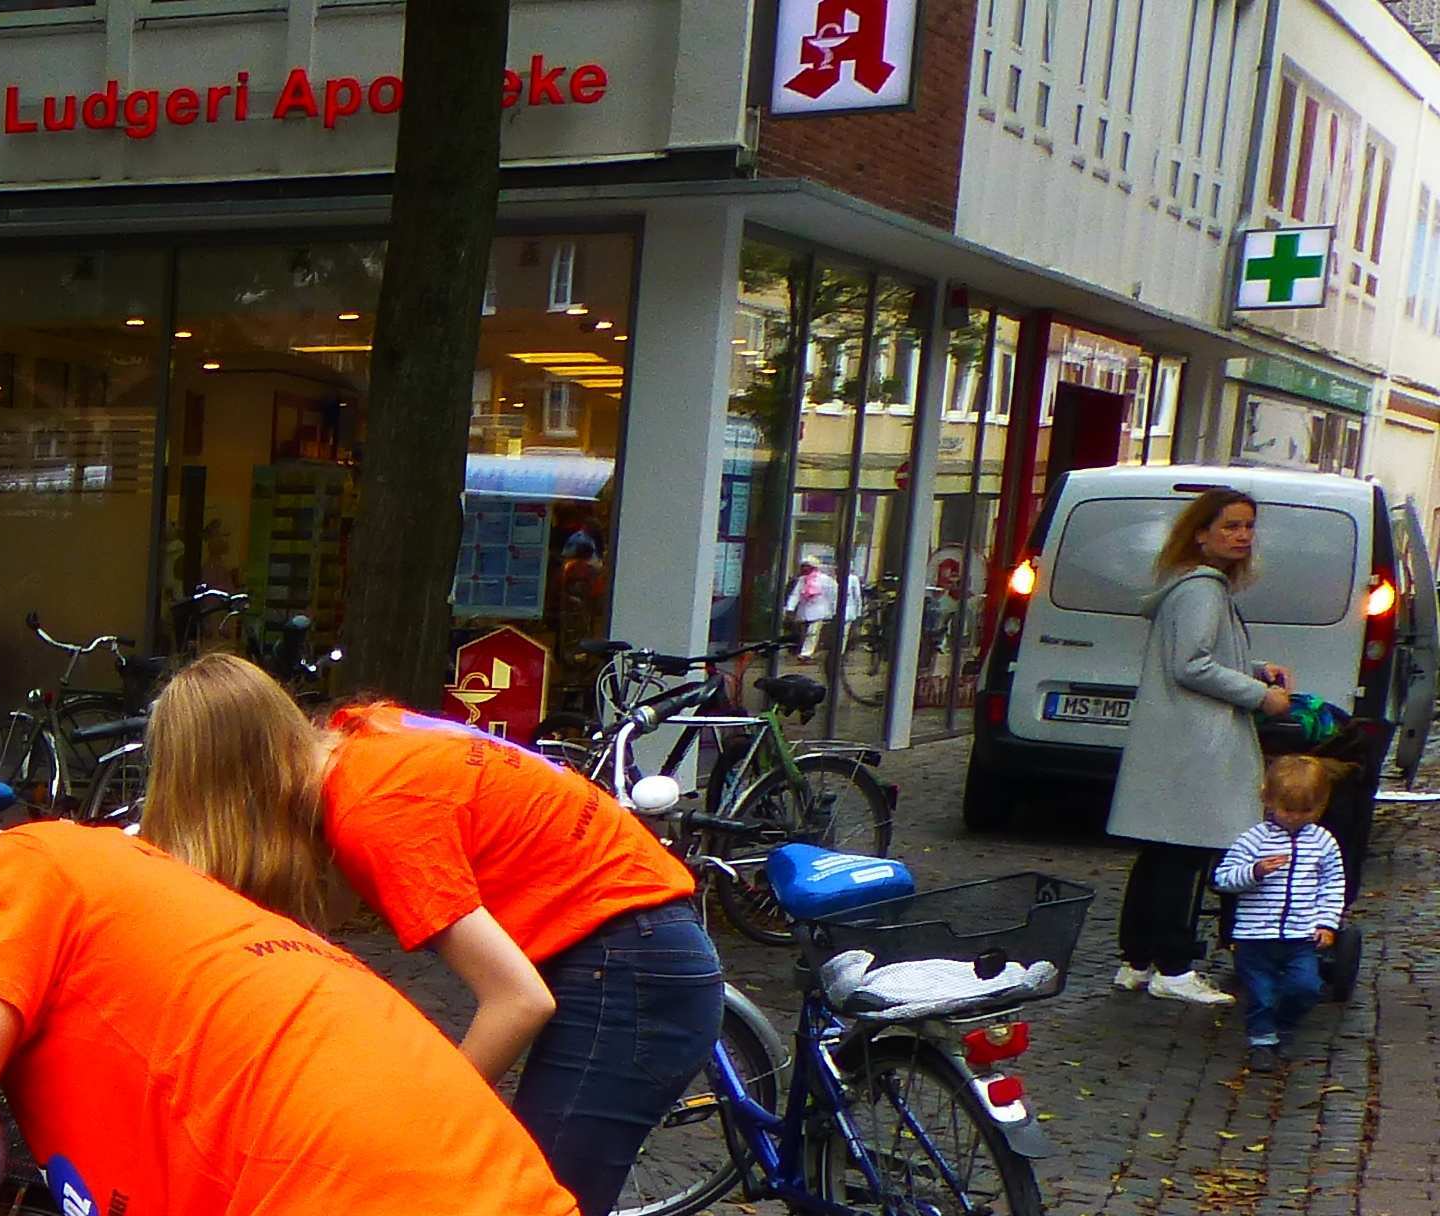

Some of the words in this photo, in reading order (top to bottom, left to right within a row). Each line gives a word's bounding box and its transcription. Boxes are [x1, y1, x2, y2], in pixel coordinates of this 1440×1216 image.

[4, 71, 249, 139] Ludgeri
[272, 53, 609, 129] Apoeke
[1063, 697, 1090, 715] MS
